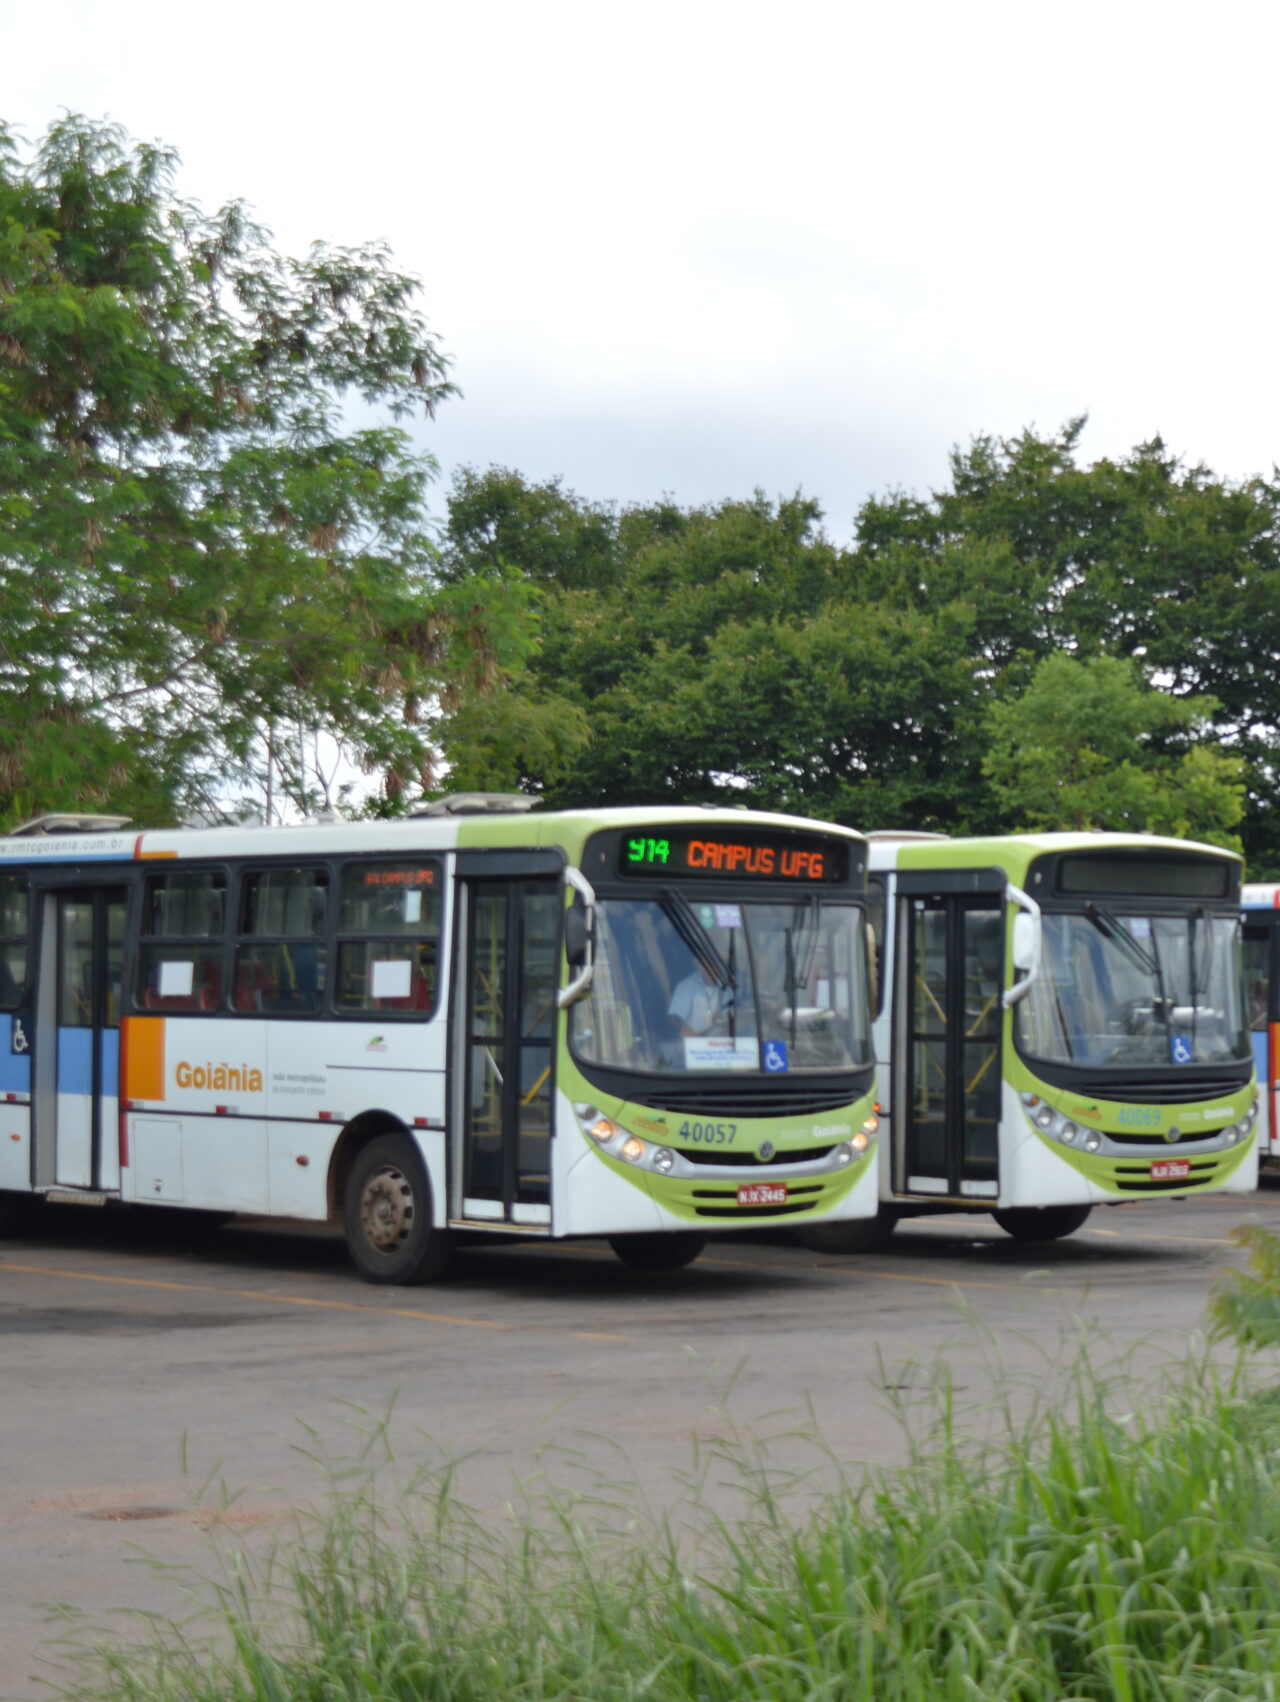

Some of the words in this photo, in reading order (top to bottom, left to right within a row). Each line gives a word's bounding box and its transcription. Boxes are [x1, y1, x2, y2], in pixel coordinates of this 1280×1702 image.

[687, 840, 776, 874] CAMPUS
[780, 851, 824, 879] UFG
[176, 1061, 263, 1092] Goiânia
[679, 1121, 738, 1145] 40057
